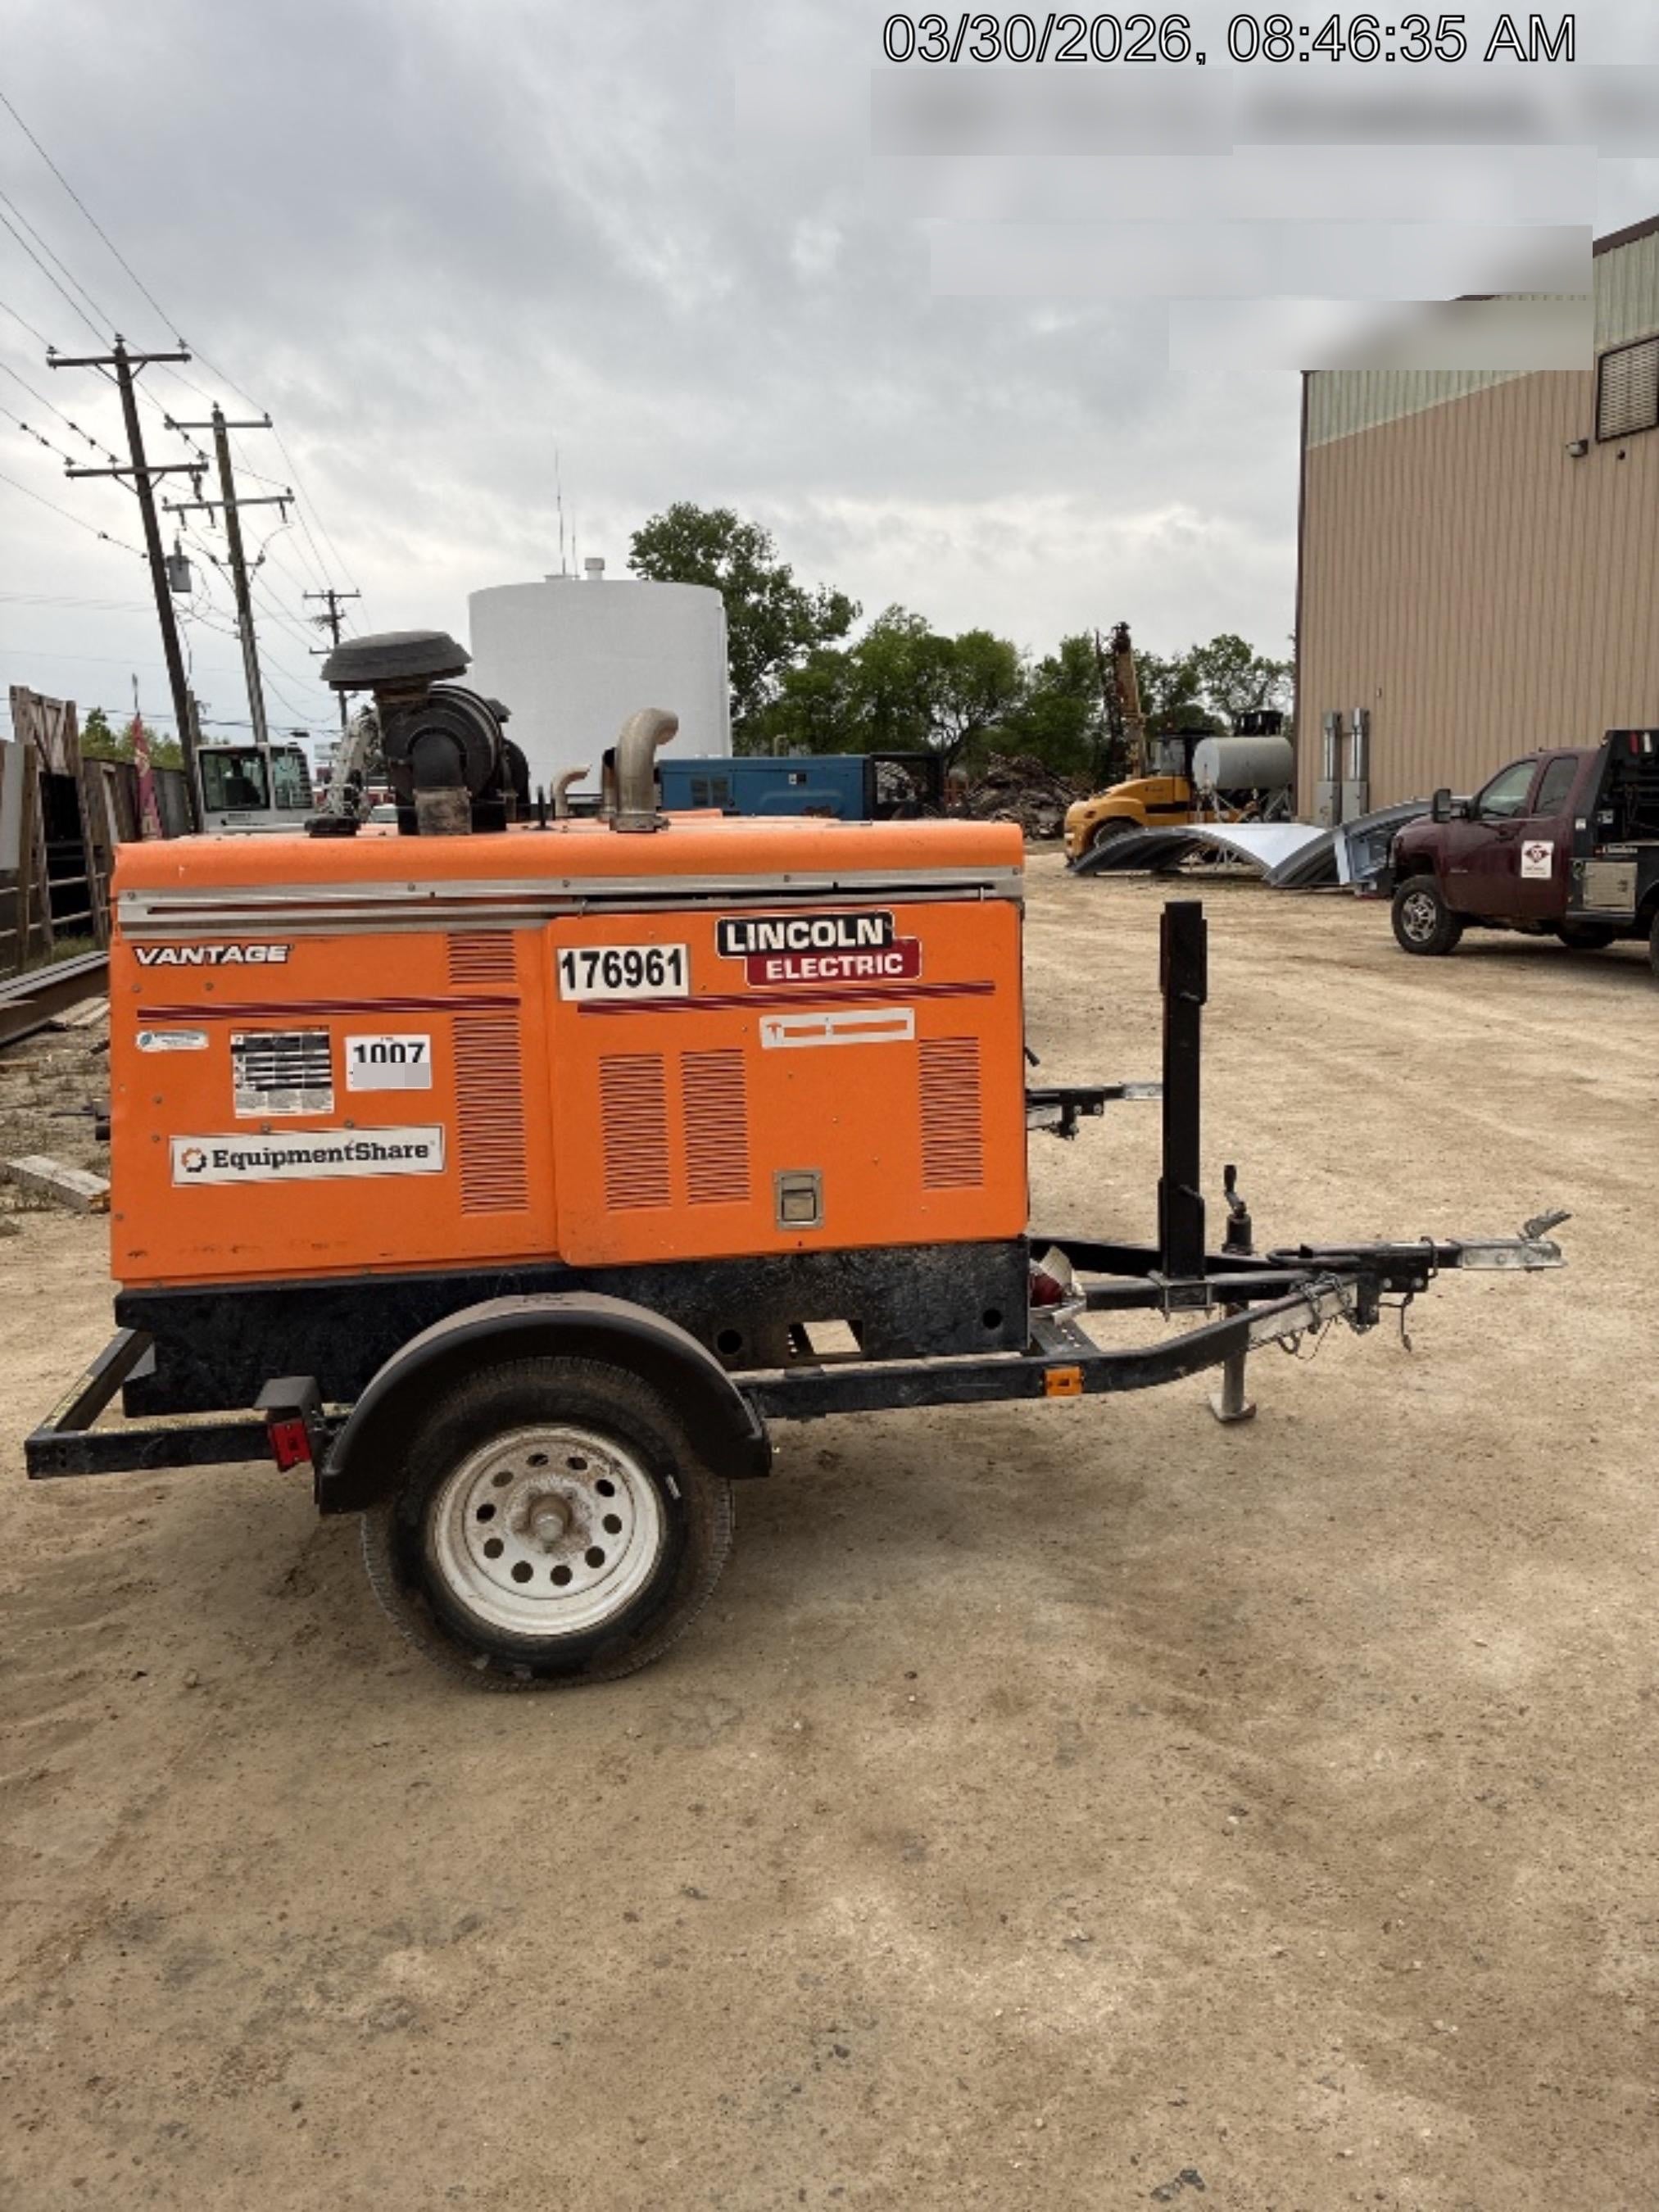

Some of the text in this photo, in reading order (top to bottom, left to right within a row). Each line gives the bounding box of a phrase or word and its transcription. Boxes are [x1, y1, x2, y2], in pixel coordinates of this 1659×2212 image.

[726, 918, 884, 952] LINCOLN
[133, 945, 288, 965] VANTAGE
[766, 953, 903, 980] ELECTRIC
[562, 948, 682, 990] 176961
[353, 1041, 425, 1063] 1007
[212, 1142, 428, 1170] EquipmentShare
